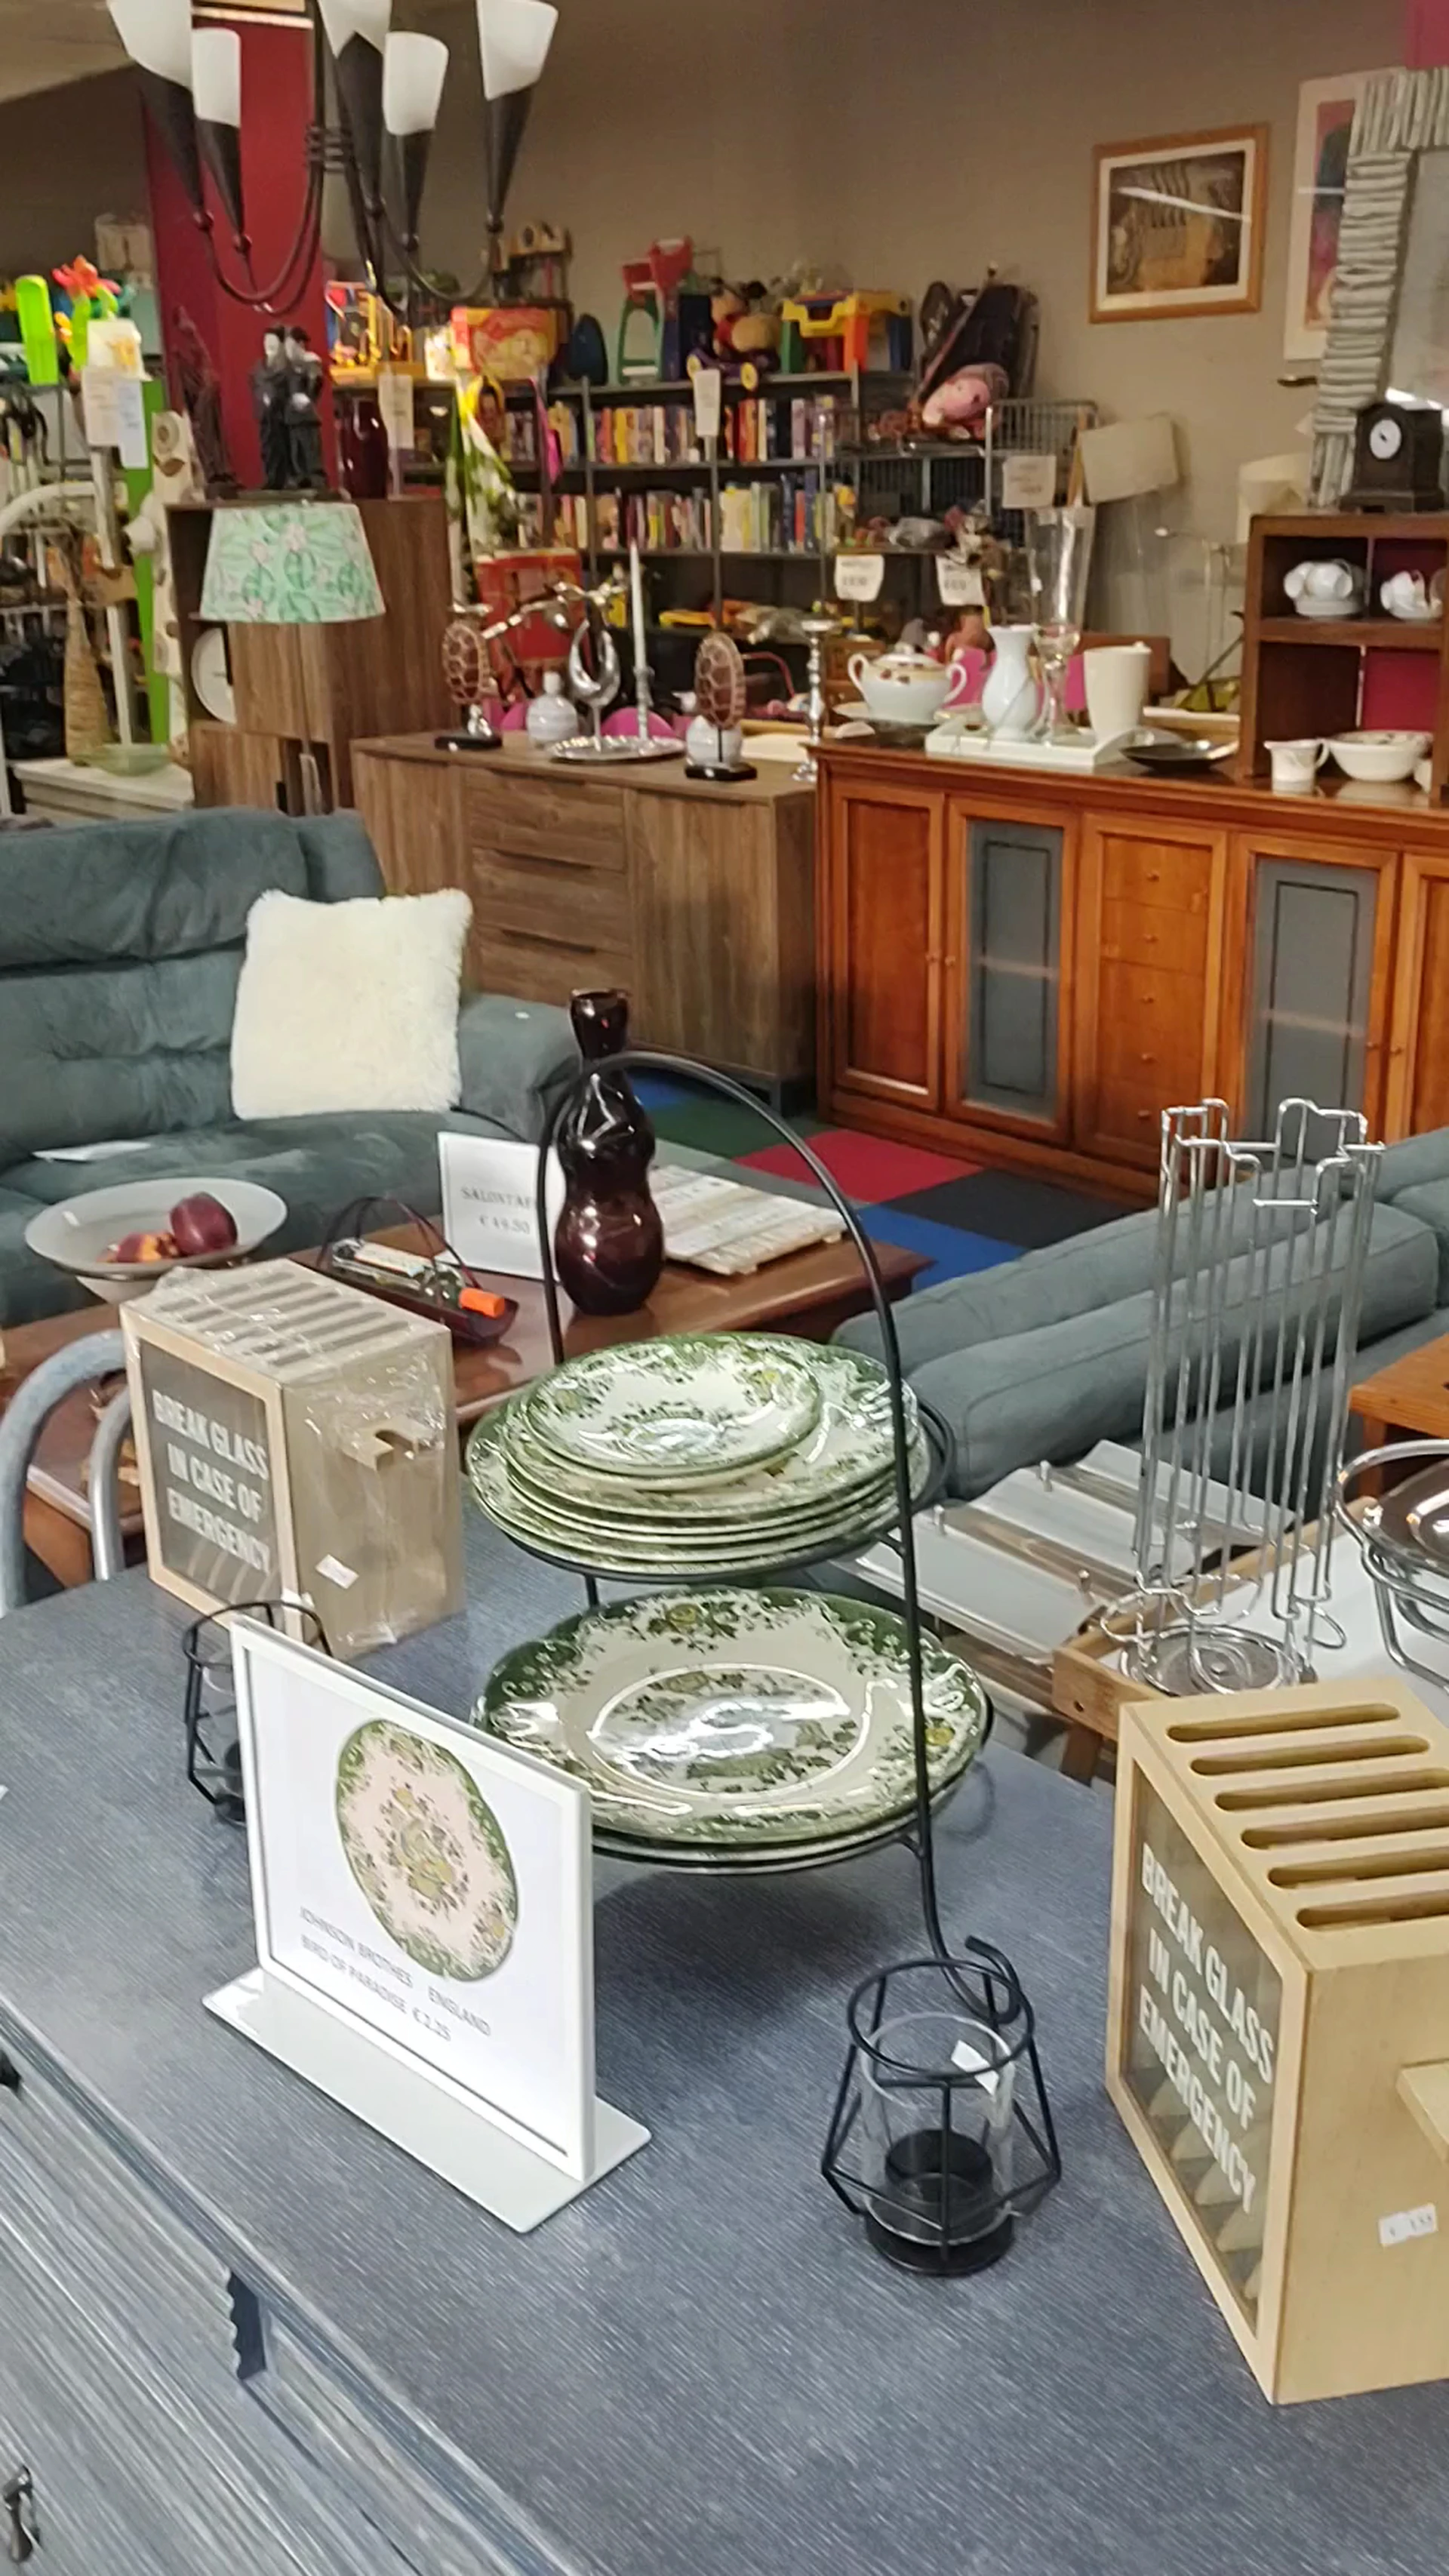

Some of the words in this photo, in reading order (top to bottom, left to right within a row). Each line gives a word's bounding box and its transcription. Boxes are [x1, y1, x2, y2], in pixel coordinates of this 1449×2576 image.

[460, 1186, 534, 1208] SALONTAF
[152, 1389, 211, 1450] BREAK
[210, 1420, 269, 1482] GLASS
[167, 1442, 189, 1482] IN
[189, 1454, 237, 1510] CASE
[237, 1482, 262, 1524] OF
[166, 1487, 270, 1575] EMERGENCY
[1141, 1842, 1204, 1976] BREAK
[1205, 1944, 1274, 2085] GLASS
[428, 1986, 491, 2036] ENGLAND
[1149, 1927, 1171, 1995] IN
[1172, 1969, 1223, 2087] CASE
[1226, 2059, 1257, 2131] OF
[1140, 1983, 1257, 2214] EMERGENCY
